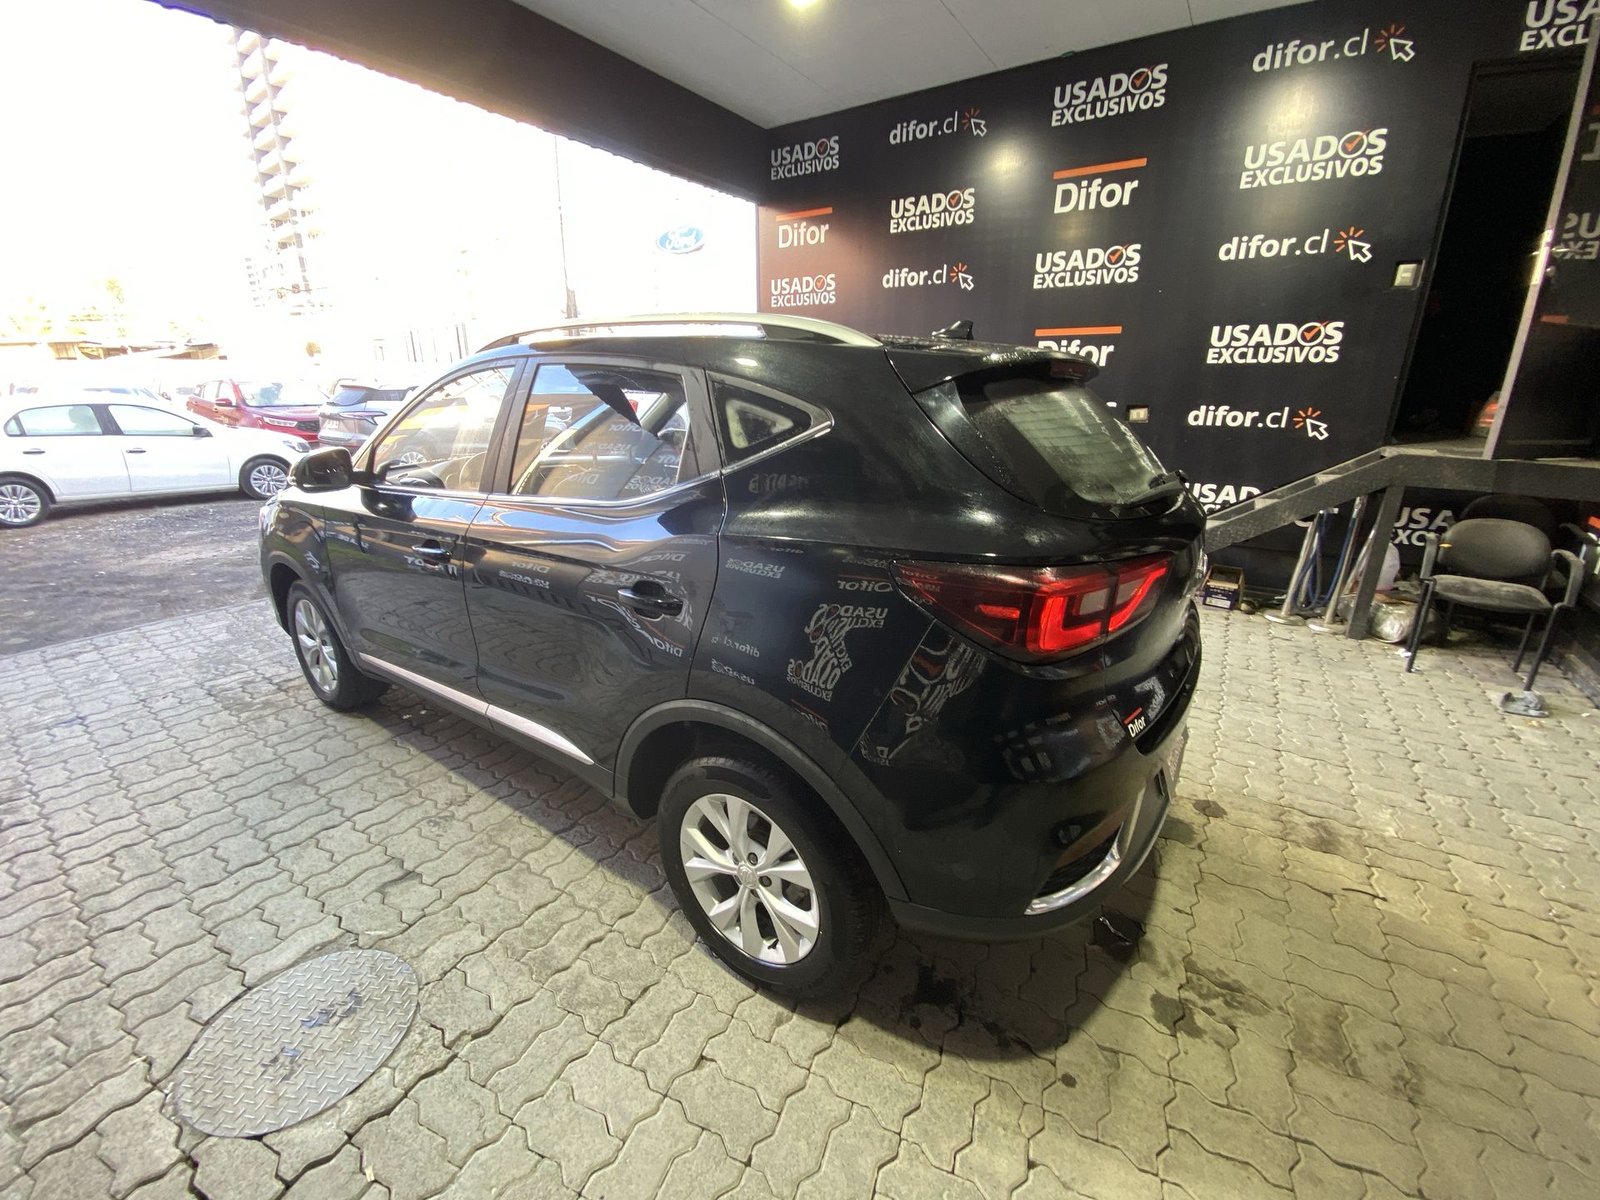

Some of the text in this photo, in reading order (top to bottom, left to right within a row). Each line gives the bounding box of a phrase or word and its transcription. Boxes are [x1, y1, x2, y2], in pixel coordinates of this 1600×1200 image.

[1252, 28, 1369, 72] difor.cl
[1053, 63, 1168, 109] USADOS
[1051, 89, 1166, 127] EXCLUSIVOS
[889, 111, 958, 145] difor.cl
[771, 136, 840, 166] USADOS
[1243, 127, 1389, 169] USADOS
[771, 154, 840, 181] EXCLUSIVOS
[1239, 154, 1384, 189] EXCLUSIVOS
[890, 187, 975, 219] USADOS
[1053, 179, 1139, 214] Difor
[778, 221, 829, 249] Difor
[889, 210, 975, 234] EXCLUSIVOS
[1034, 243, 1142, 274] USADOS
[1217, 228, 1330, 261] difor.cl
[771, 273, 836, 295] USADOS
[882, 264, 947, 289] difor.cl
[1032, 267, 1140, 289] EXCLUSIVOS
[771, 291, 836, 308] EXCLUSIVOS
[1209, 320, 1345, 348] USADOS
[1206, 344, 1340, 364] EXCLUSIVOS
[1187, 406, 1290, 429] difor.cl
